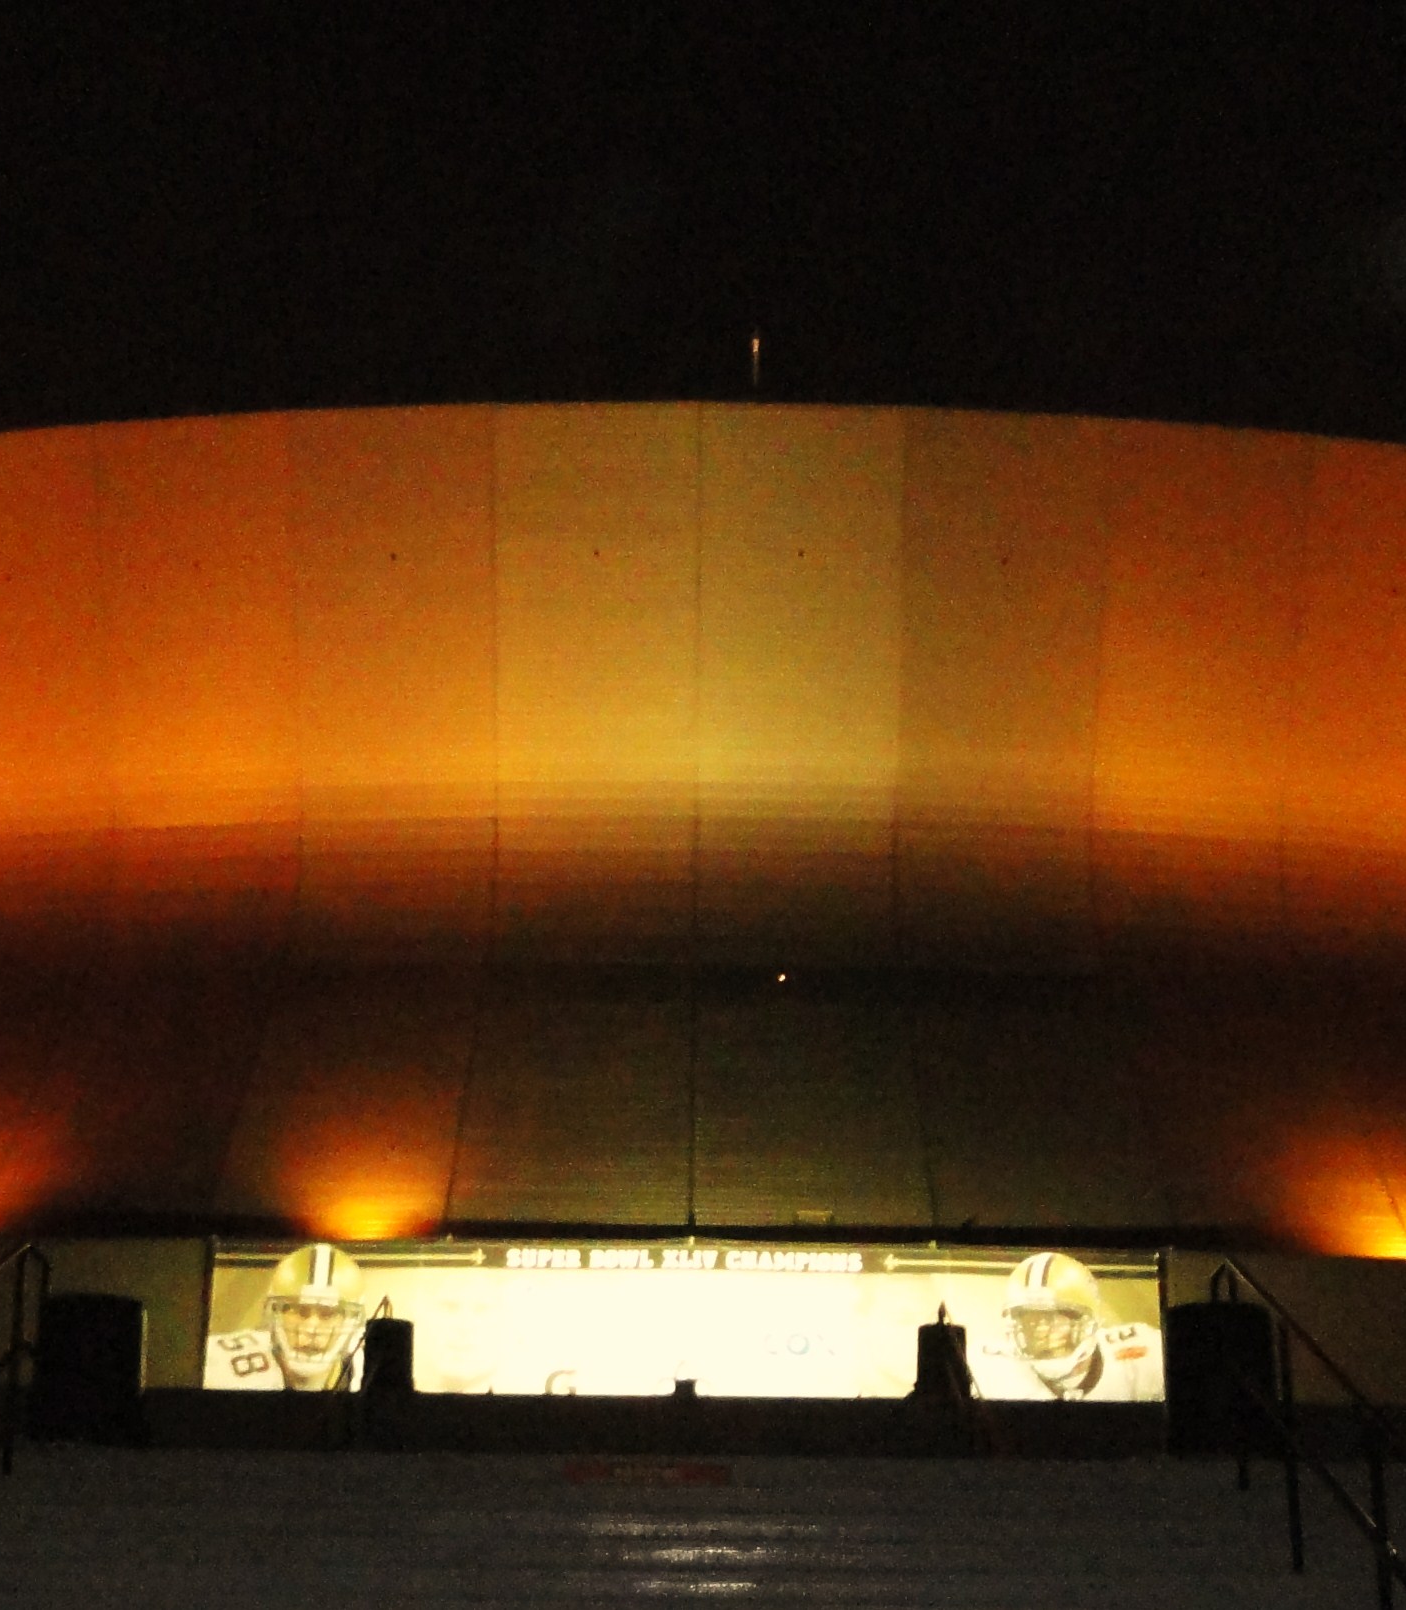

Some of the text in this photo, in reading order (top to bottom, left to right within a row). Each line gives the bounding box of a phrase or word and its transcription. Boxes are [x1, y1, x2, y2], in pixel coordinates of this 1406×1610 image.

[505, 1248, 864, 1272] SUPER BOWL XLIV CHAMPIONS
[217, 1333, 270, 1378] 58
